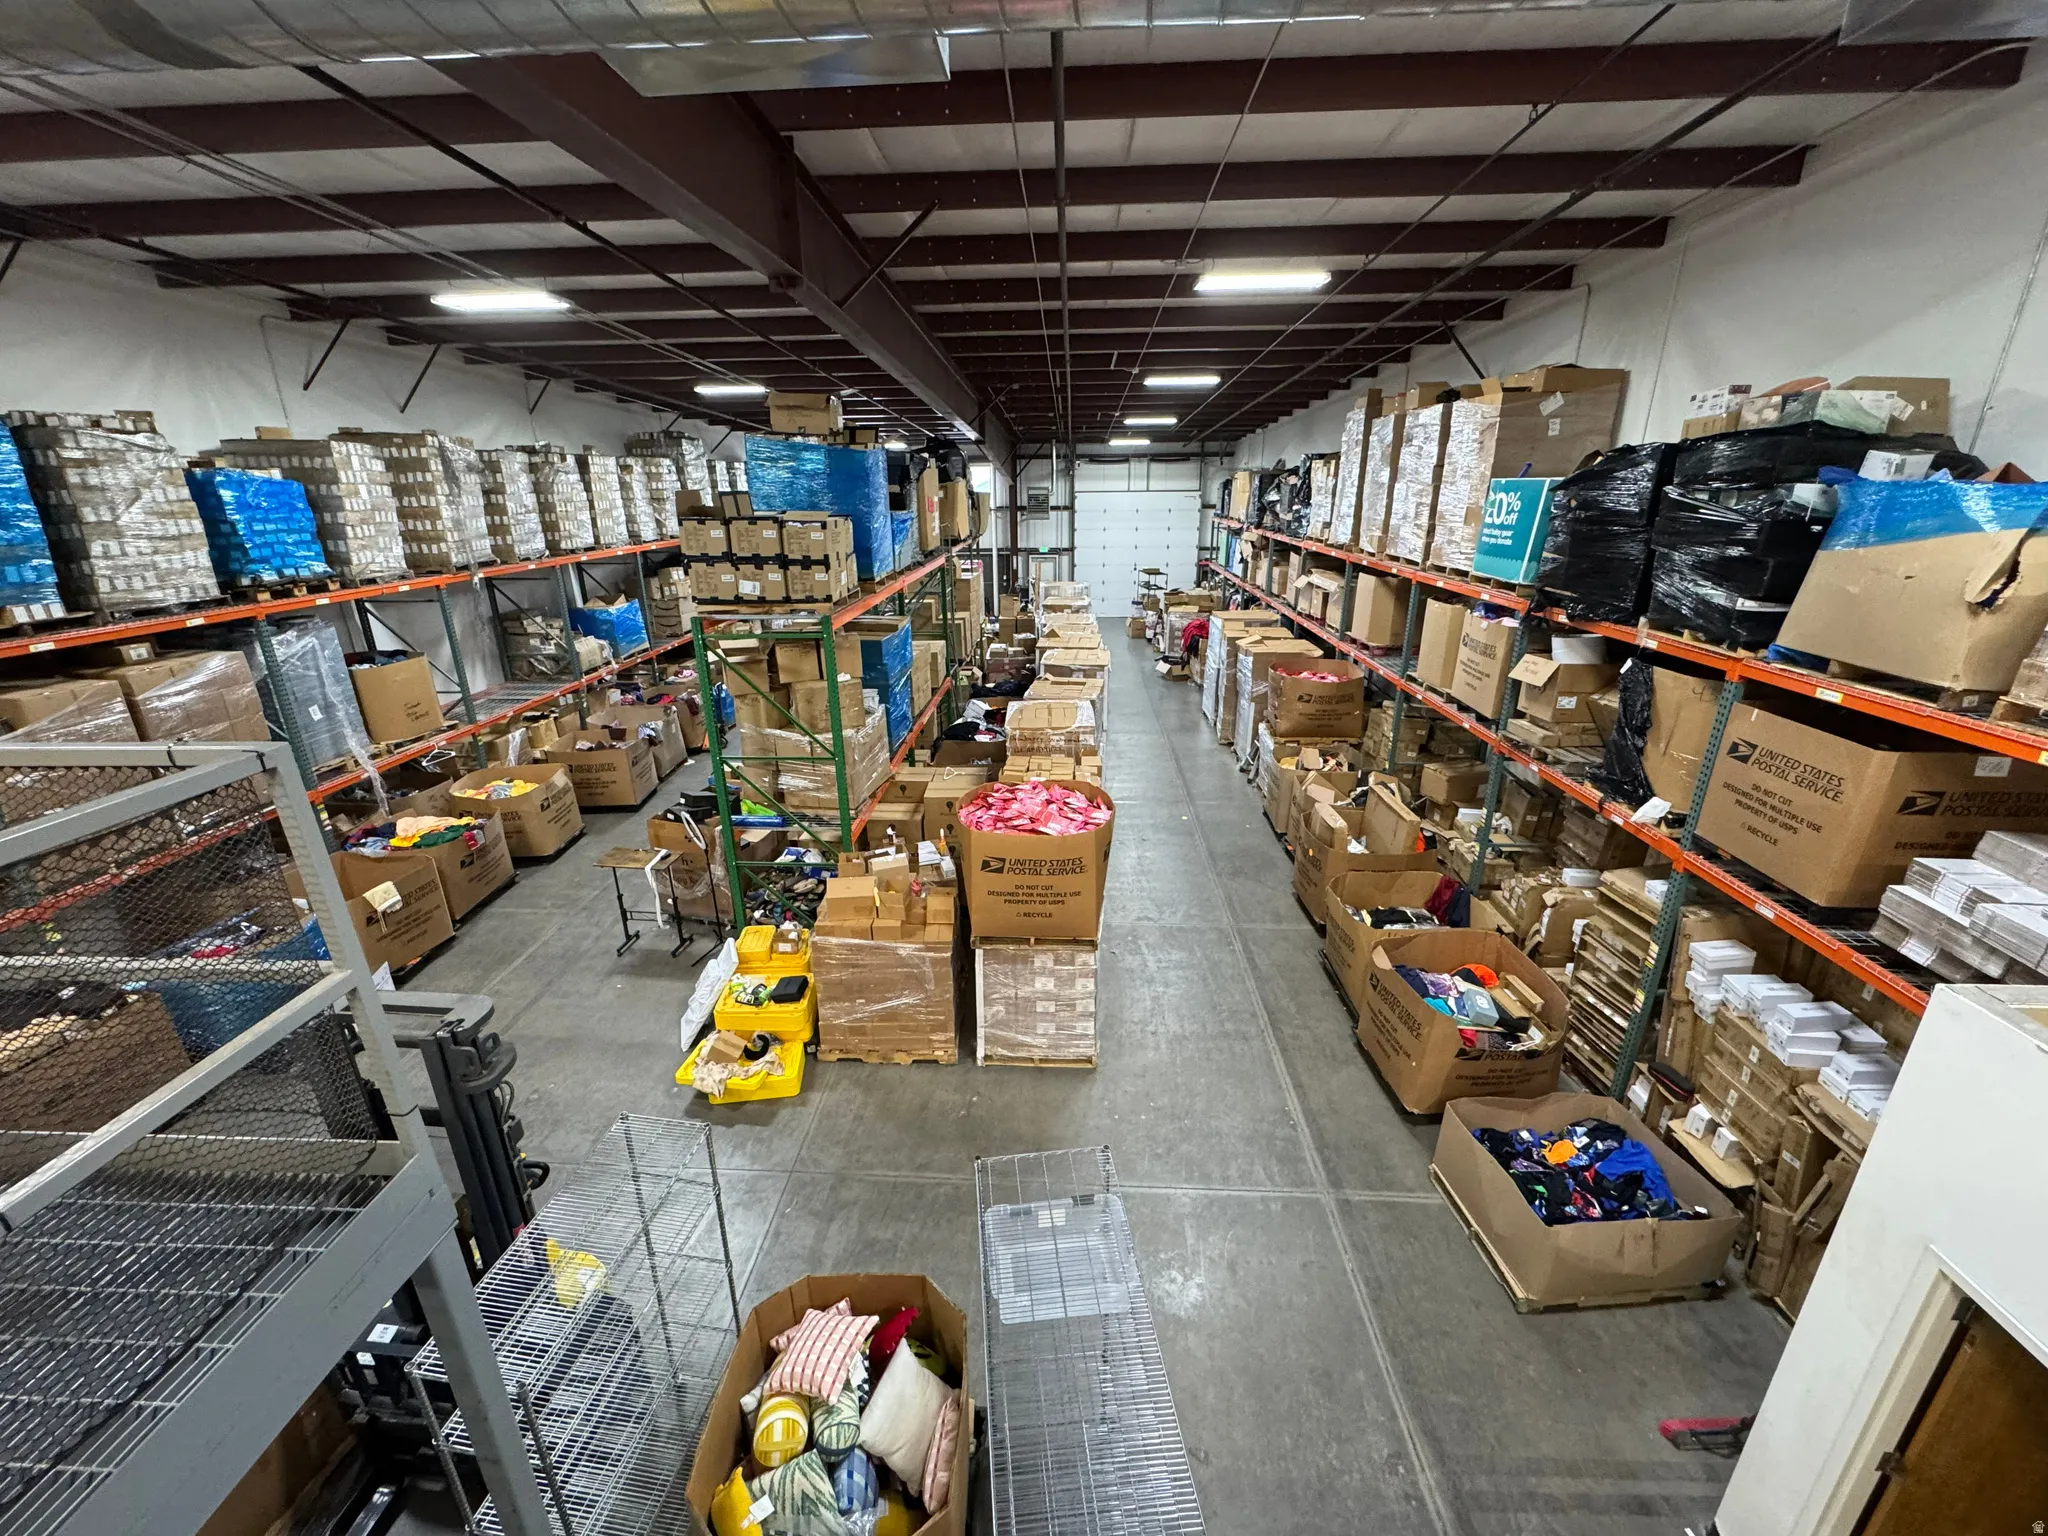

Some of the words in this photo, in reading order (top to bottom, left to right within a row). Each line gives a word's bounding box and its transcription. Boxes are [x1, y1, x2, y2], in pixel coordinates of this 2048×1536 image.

[1503, 512, 1519, 525] off
[1758, 747, 1801, 770] UNITED
[1799, 764, 1845, 788] STATES
[1751, 758, 1790, 782] POSTAL
[1791, 774, 1843, 803] SERVICE
[1751, 783, 1762, 793] DO
[1762, 789, 1778, 799] NOT
[1777, 795, 1793, 807] CUT
[1948, 791, 2011, 803] UNITED
[1722, 781, 1754, 801] DESIGNED
[1755, 797, 1769, 809] FOR
[1769, 803, 1805, 826] MULTIPLE
[1805, 820, 1822, 834] USE
[1734, 798, 1768, 820] PROPERTY
[1767, 815, 1779, 825] OF
[1778, 822, 1799, 835] USPS
[1939, 804, 2001, 817] POSTAL
[1746, 824, 1779, 847] RECYCLE
[1006, 867, 1045, 876] POSTAL
[1046, 865, 1087, 876] SERVICE
[1008, 858, 1047, 868] UNITED
[1048, 857, 1084, 868] STATES
[1377, 989, 1396, 1016] POSTAL
[1396, 1012, 1422, 1041] SERVICE
[1380, 982, 1401, 1008] UNITED
[1400, 1005, 1422, 1031] STATES
